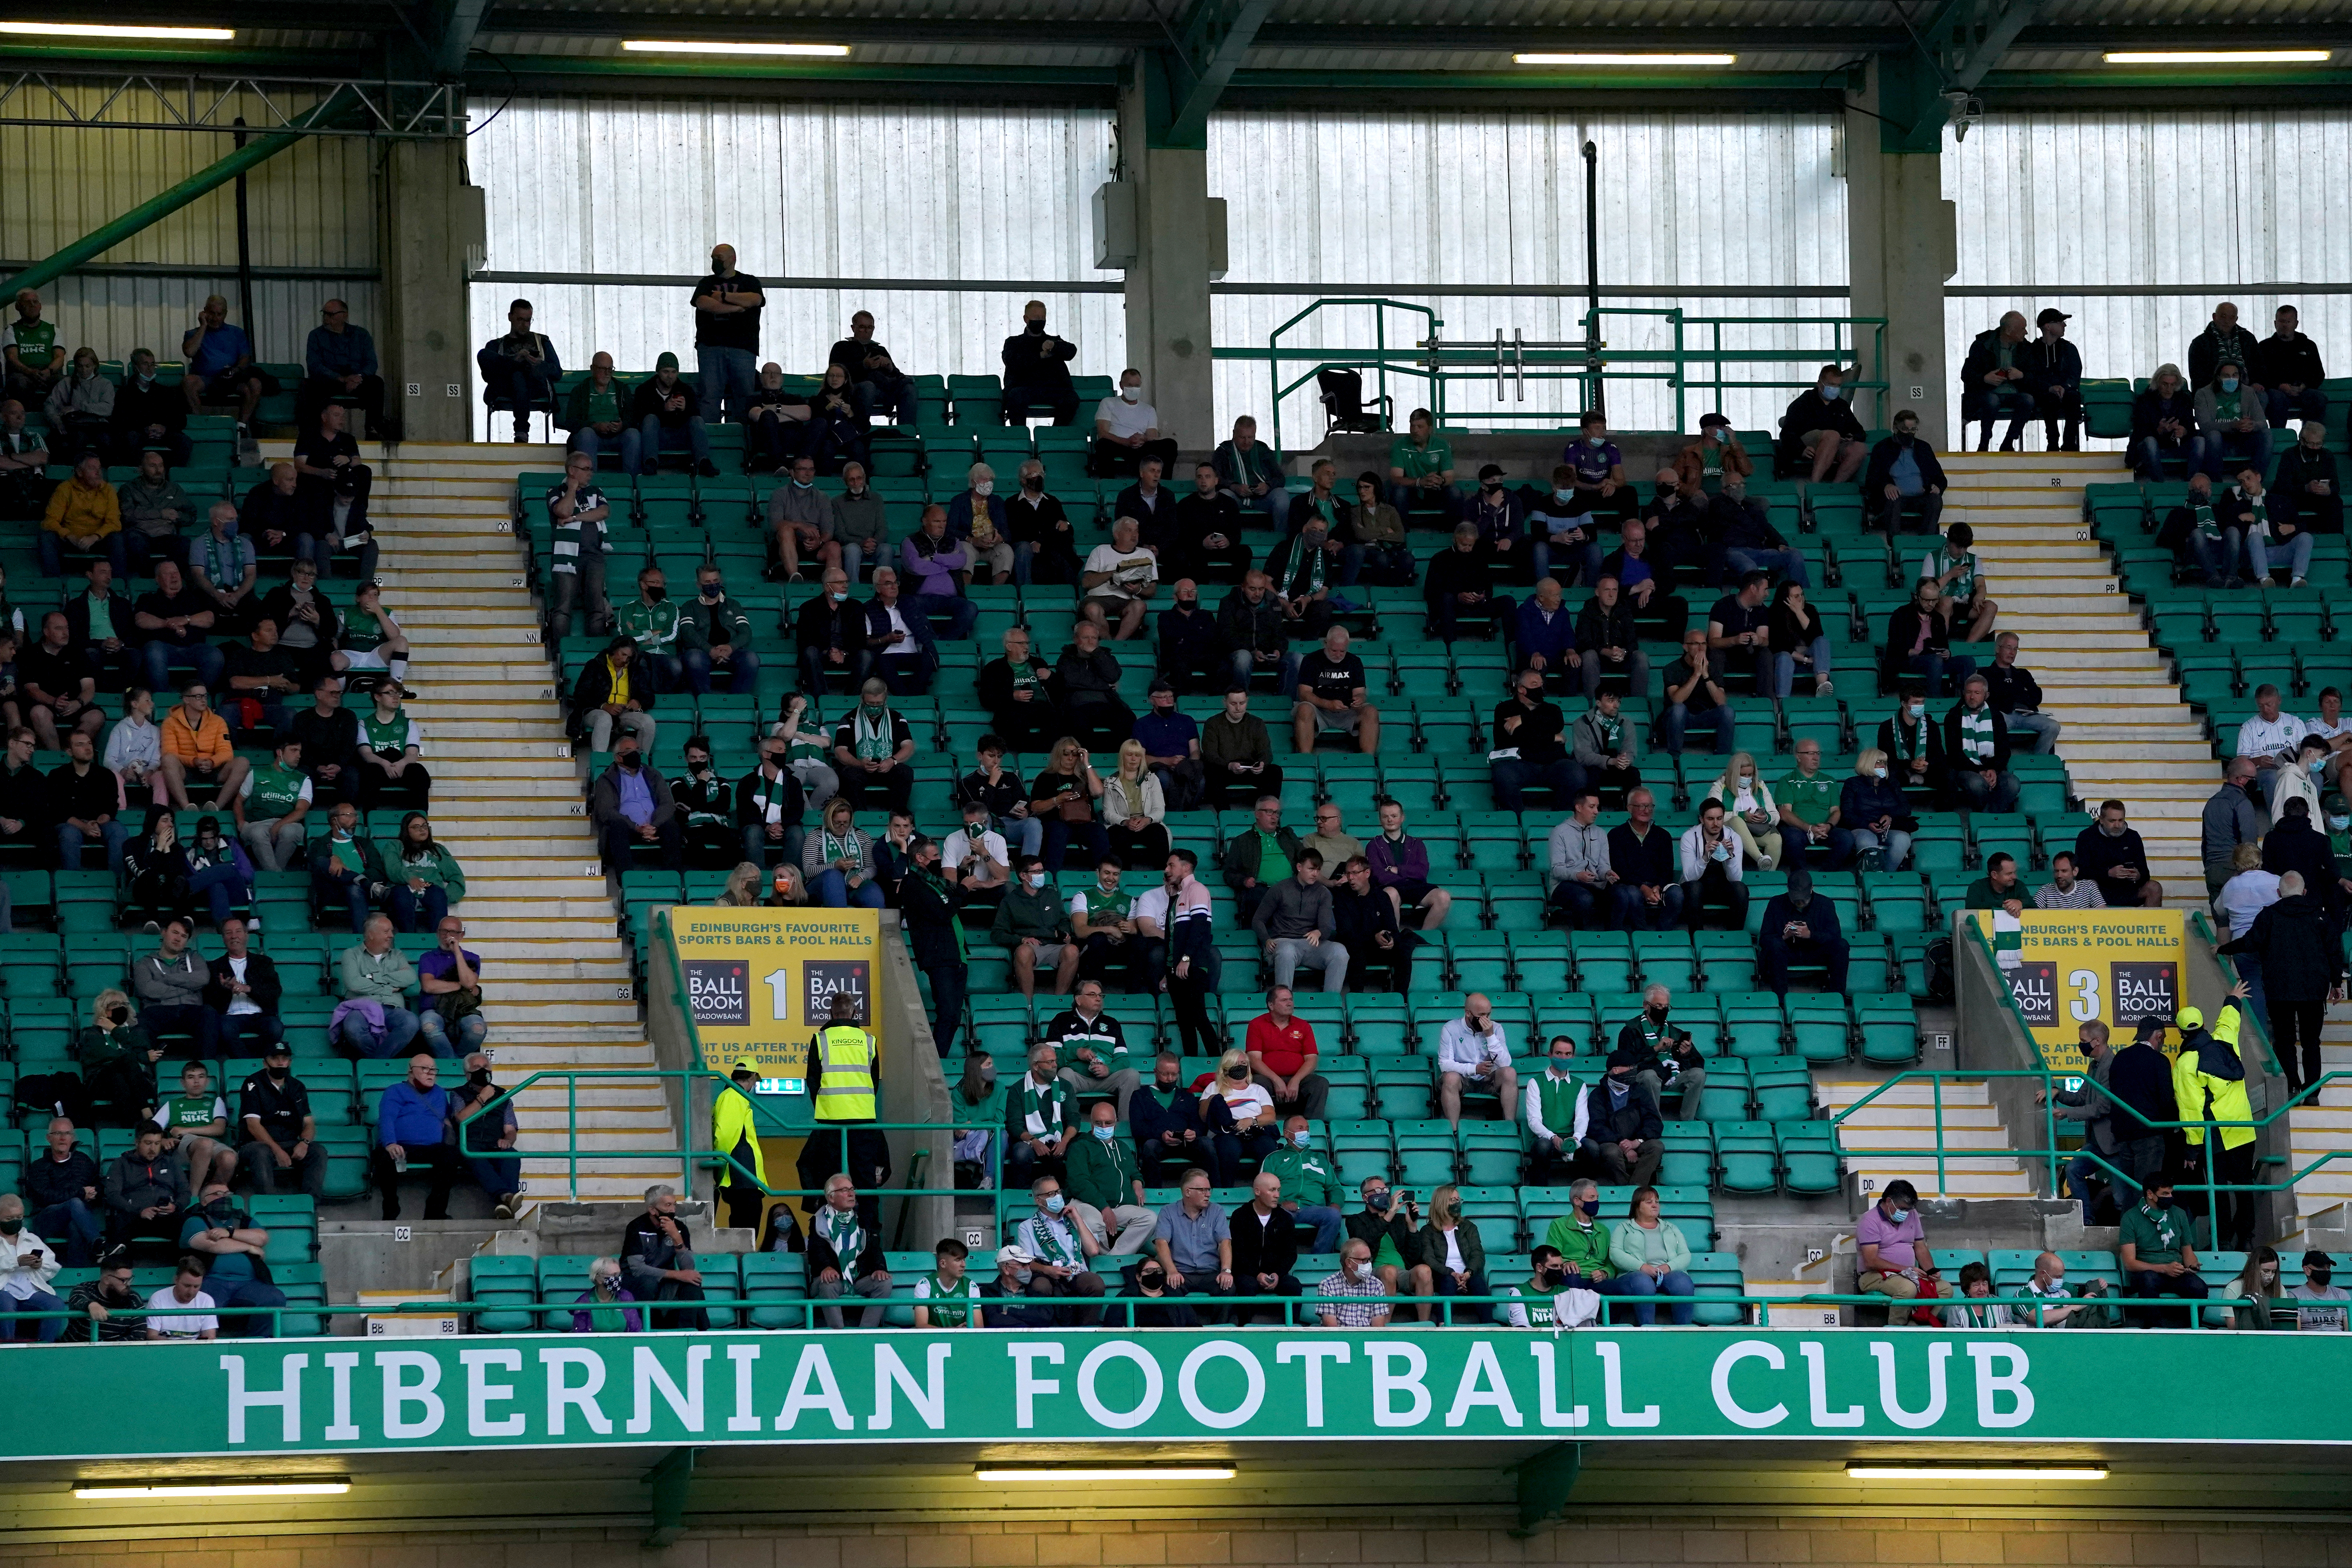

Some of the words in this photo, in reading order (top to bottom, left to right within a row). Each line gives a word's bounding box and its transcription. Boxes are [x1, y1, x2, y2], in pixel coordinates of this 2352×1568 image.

[409, 385, 418, 394] SS
[449, 385, 458, 395] SS
[1912, 388, 1921, 397] SS
[2051, 478, 2061, 487] RR
[2076, 531, 2087, 541] QQ
[2106, 584, 2115, 594] PP
[527, 634, 536, 643] NN
[541, 689, 552, 699] MM
[2262, 742, 2285, 751] utilita
[557, 747, 565, 757] LL
[261, 792, 286, 800] utilita
[571, 806, 581, 814] KK
[2089, 808, 2099, 817] KK
[587, 866, 596, 875] JJ
[690, 923, 782, 933] EDINBURGH'S
[786, 923, 860, 933] FAVOURITE
[2021, 925, 2088, 934] NBURGH'S
[2093, 925, 2166, 934] FAVOURITE
[678, 935, 732, 945] SPORTS
[736, 935, 771, 945] BARS
[775, 936, 785, 945] &
[790, 936, 825, 945] POOL
[830, 936, 872, 945] HALLS
[1986, 937, 2039, 946] STS
[2043, 937, 2078, 946] BARS
[2083, 937, 2092, 946] &
[2097, 937, 2132, 946] POOL
[2137, 937, 2179, 946] HALLS
[690, 977, 742, 995] BALL
[811, 977, 862, 995] BALL
[2119, 979, 2171, 996] BALL
[618, 988, 629, 998] GG
[764, 968, 787, 1020] 1
[2069, 969, 2101, 1022] 3
[692, 996, 742, 1010] ROOM
[811, 996, 863, 1010] ROM
[2014, 997, 2051, 1011] OOM
[2120, 997, 2172, 1011] ROOM
[1938, 1037, 1947, 1047] FF
[722, 1043, 739, 1052] US
[740, 1043, 787, 1052] AFTER
[791, 1043, 809, 1052] TH
[2054, 1044, 2081, 1053] AFT
[704, 1055, 719, 1064] TO
[756, 1055, 797, 1064] DRINK
[2044, 1056, 2061, 1067] AT,
[2066, 1056, 2093, 1065] DRI
[181, 1114, 210, 1123] NHS
[1863, 1180, 1874, 1190] DD
[397, 1229, 408, 1239] CC
[968, 1234, 980, 1245] CC
[1810, 1251, 1821, 1261] CC
[934, 1307, 966, 1317] Community
[1532, 1312, 1553, 1322] NH
[1824, 1314, 1835, 1323] BB
[372, 1323, 383, 1333] BB
[442, 1321, 453, 1332] BB
[220, 1343, 952, 1443] HIBERNIAN
[1007, 1339, 1660, 1429] FOOTBALL
[1710, 1339, 2035, 1429] CLUB
